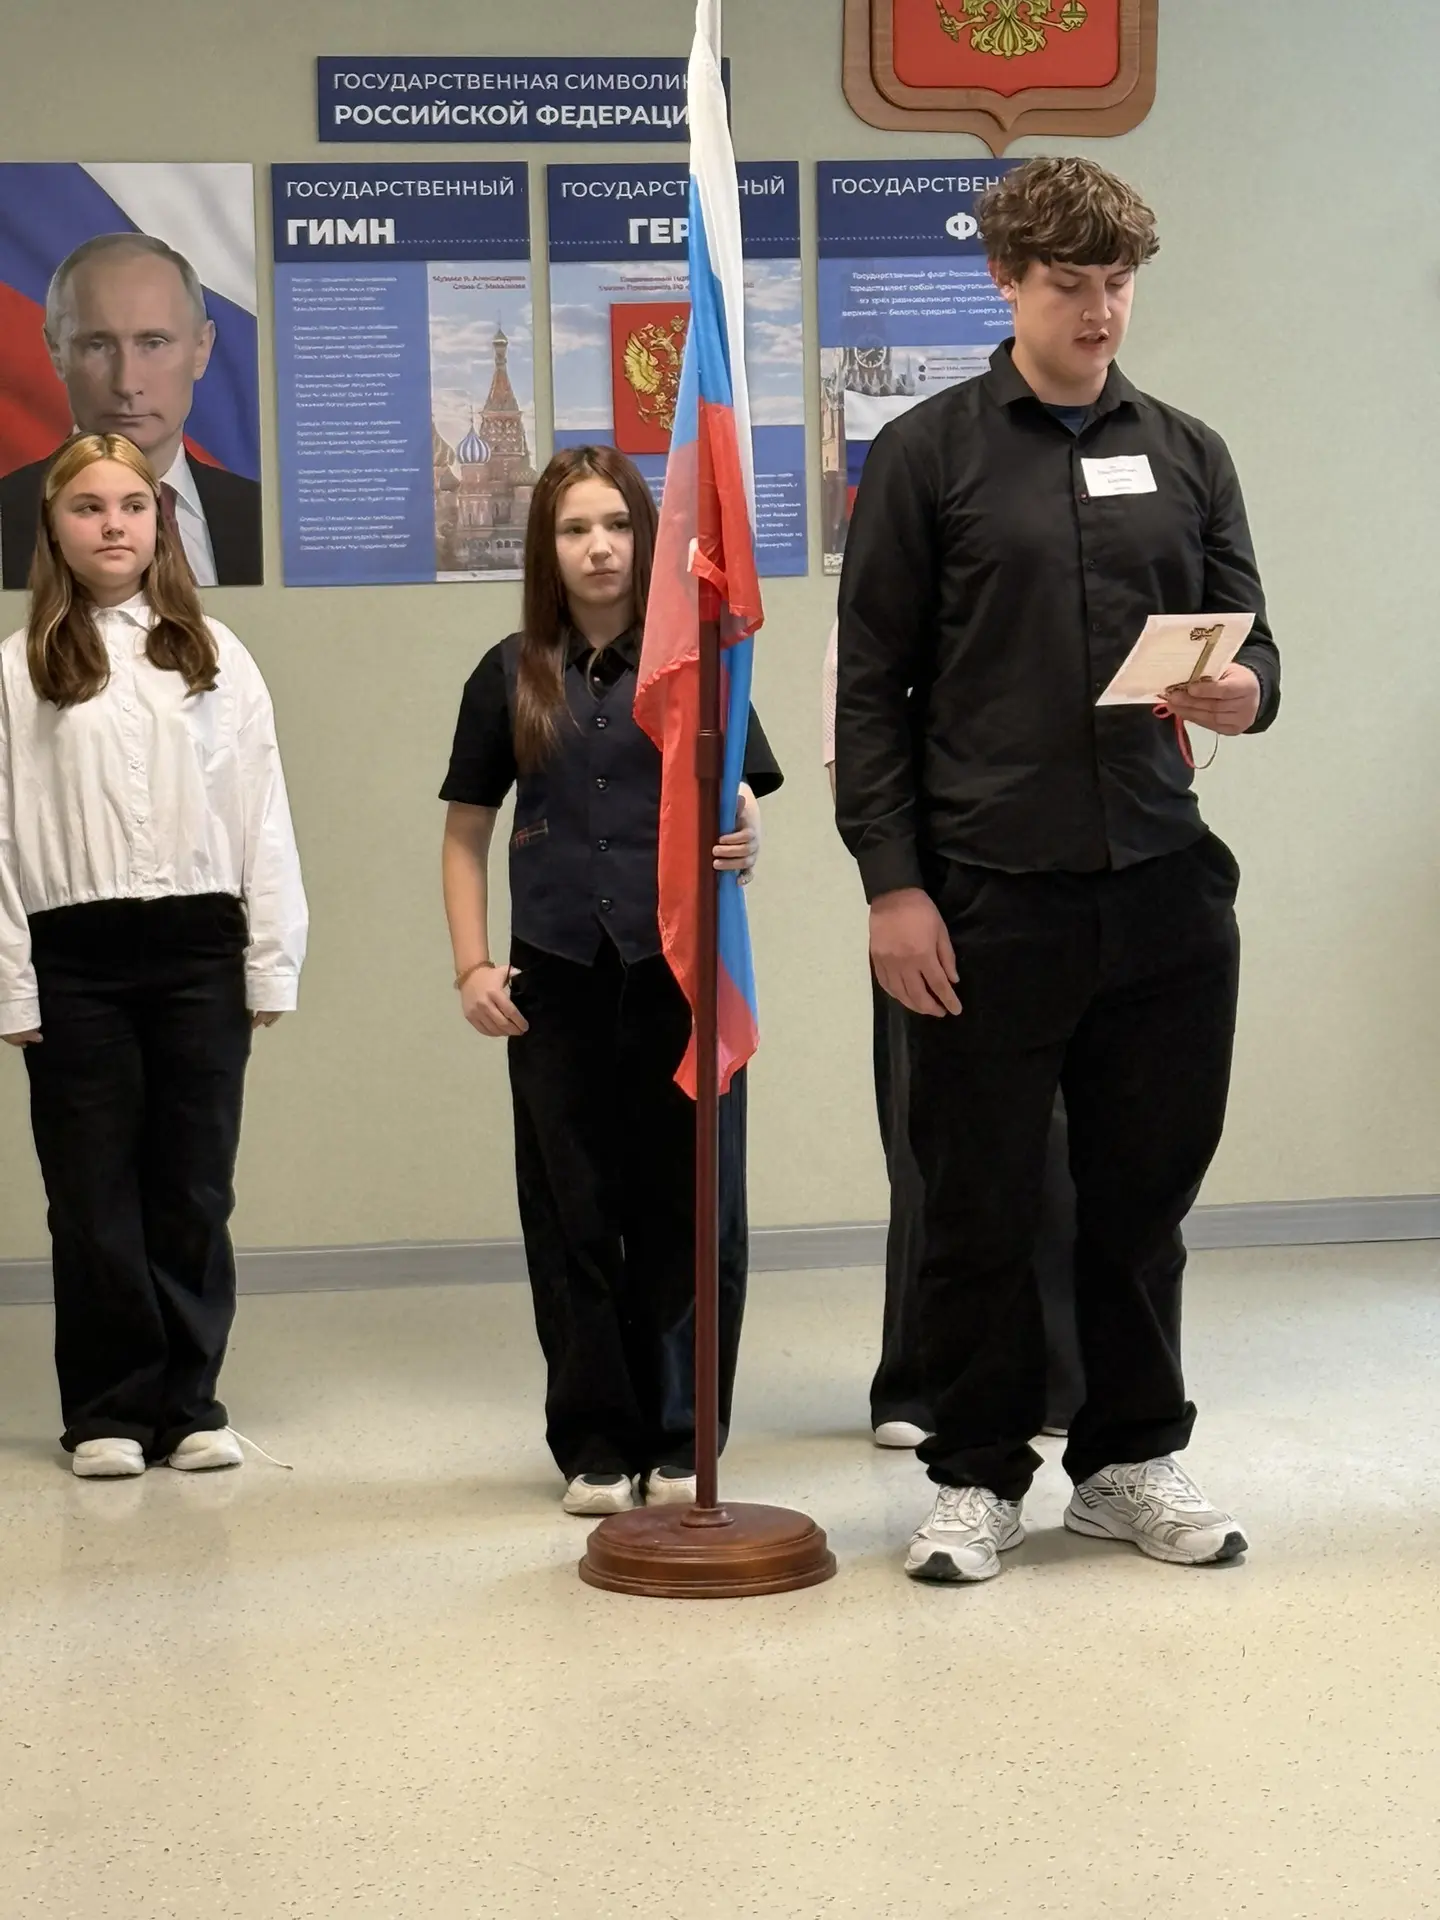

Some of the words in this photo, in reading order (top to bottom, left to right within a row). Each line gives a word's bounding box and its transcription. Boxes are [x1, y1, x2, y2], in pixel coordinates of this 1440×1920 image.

[333, 73, 559, 93] ГОСУДАРСТВЕННАЯ
[334, 99, 529, 126] РОССИЙСКОЙ
[535, 104, 690, 129] ФЕДЕРАЦИ
[286, 176, 515, 200] ГОСУДАРСТВЕННЫЙ
[560, 175, 786, 200] ГОСУДАРСТНЫЙ
[832, 175, 1006, 197] ГОСУДАРСТВЕН
[287, 218, 396, 246] ГИМН
[628, 217, 690, 245] ГЕР
[945, 212, 983, 240] Ф
